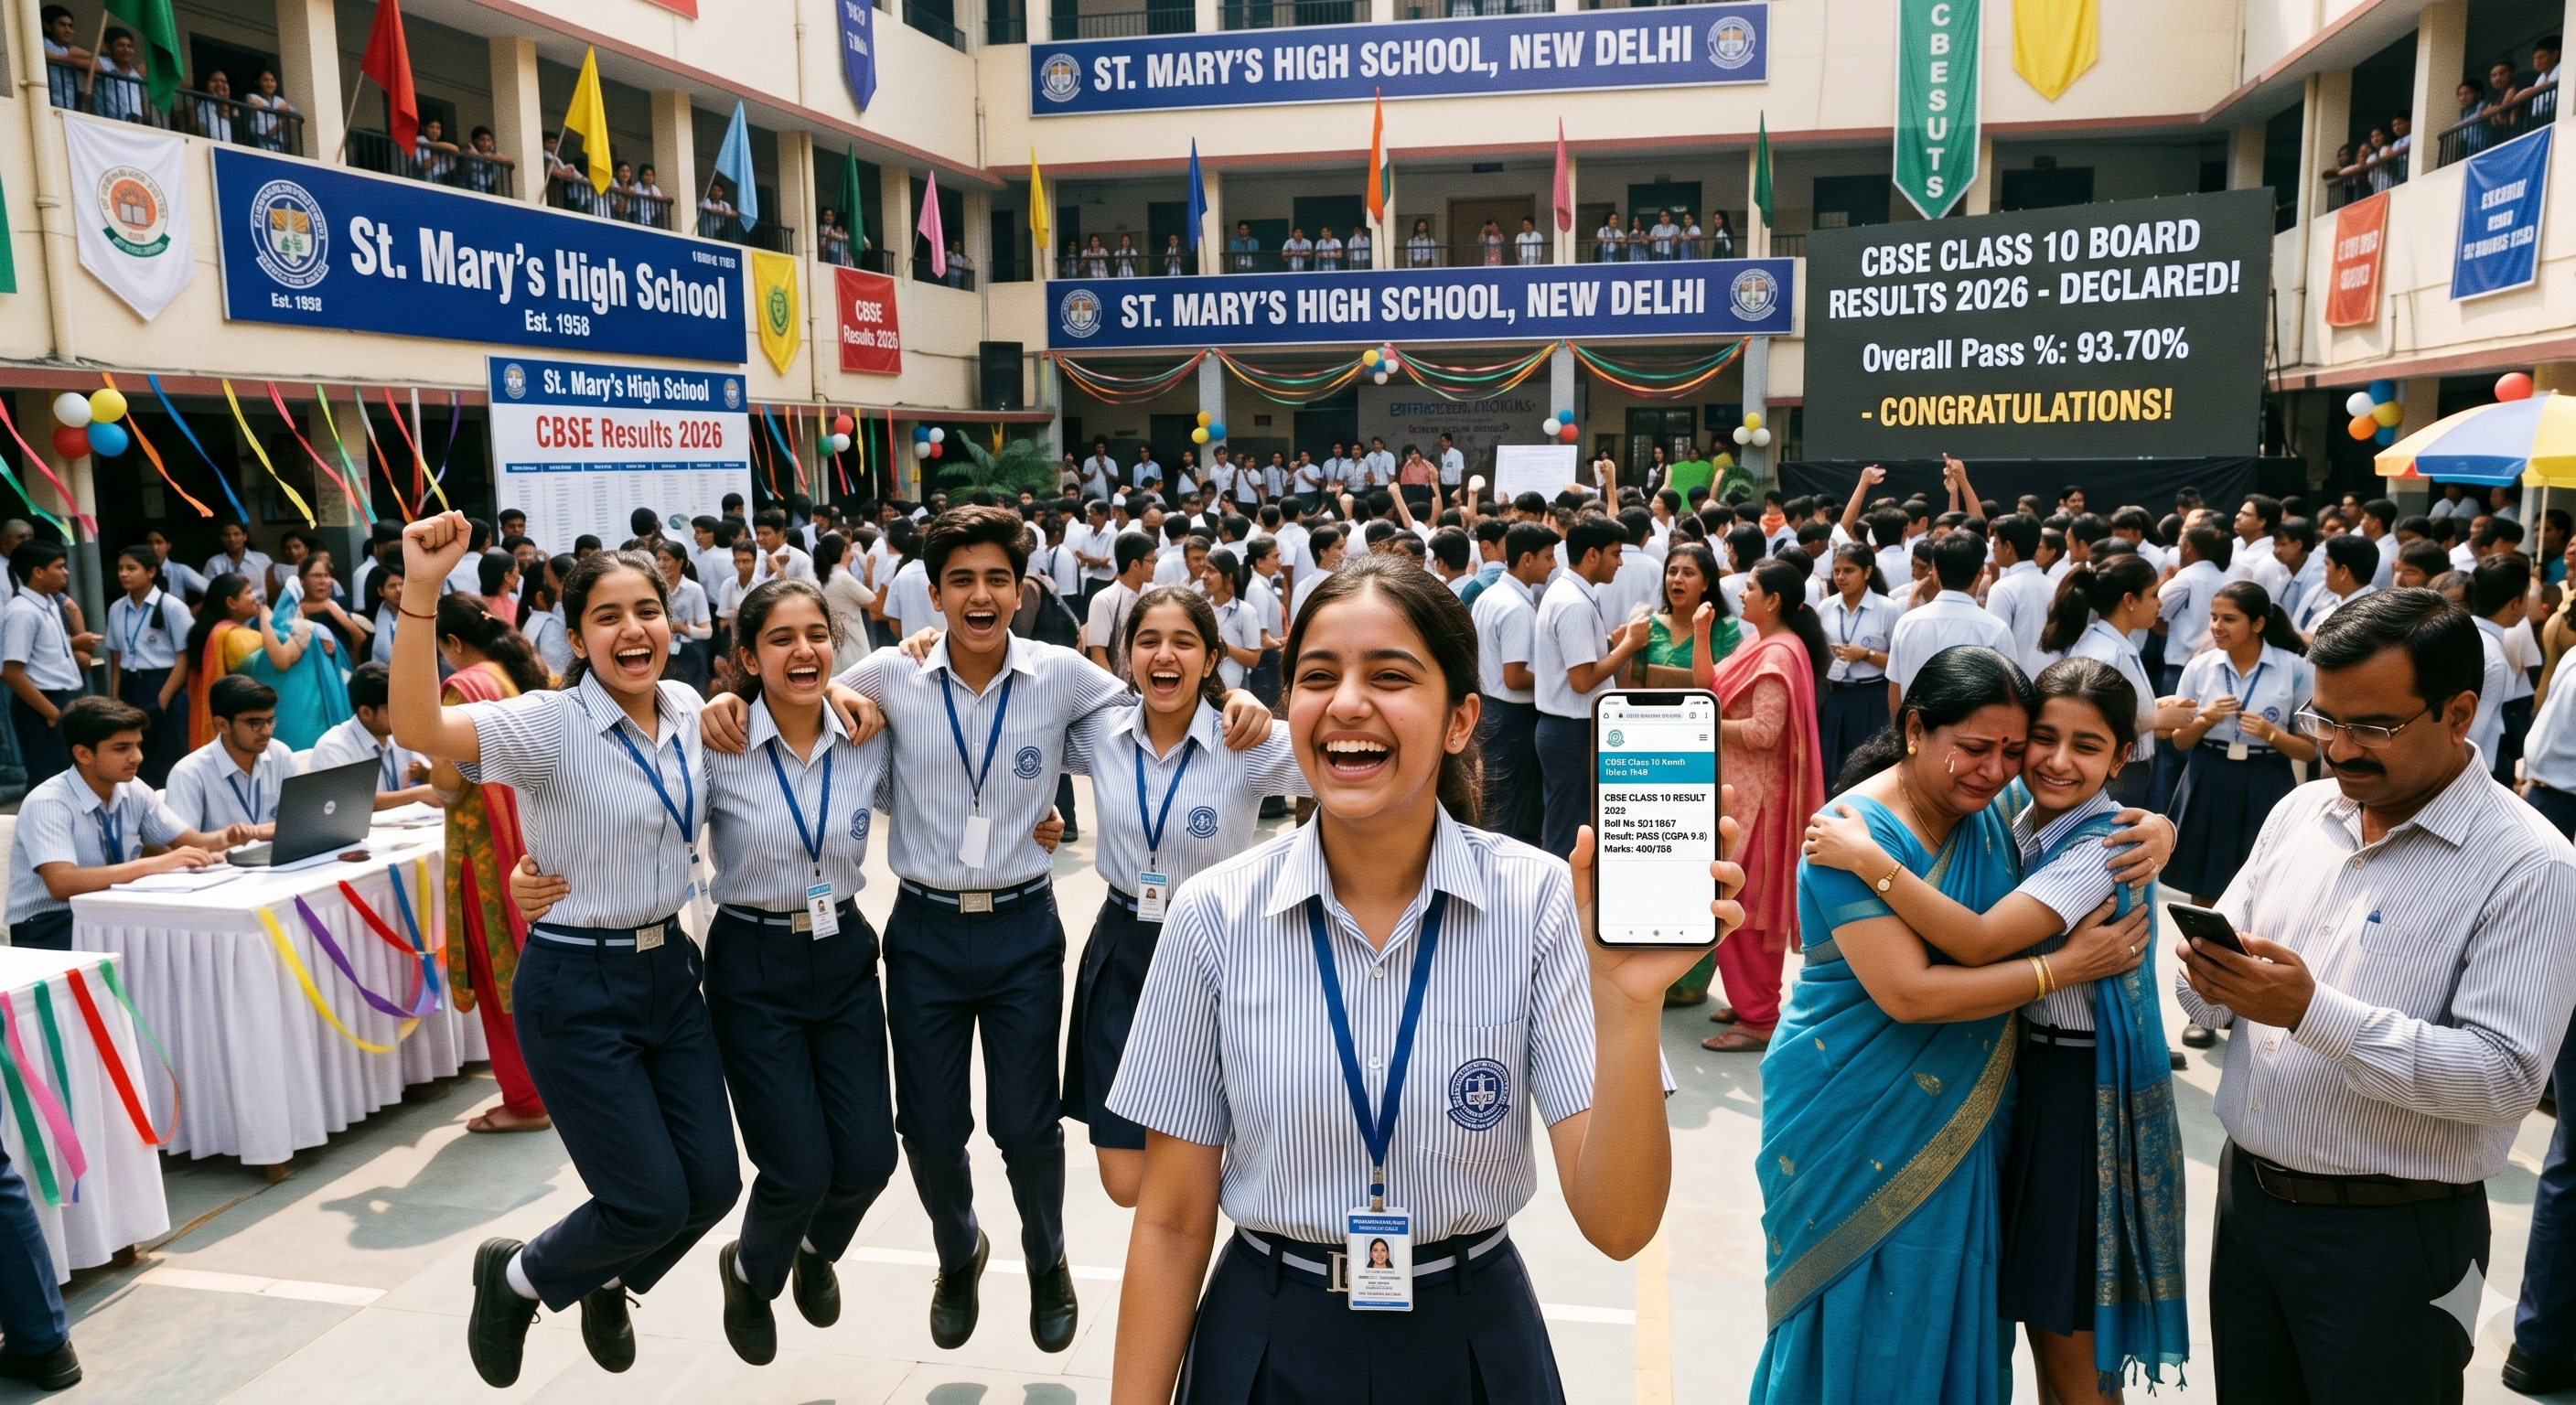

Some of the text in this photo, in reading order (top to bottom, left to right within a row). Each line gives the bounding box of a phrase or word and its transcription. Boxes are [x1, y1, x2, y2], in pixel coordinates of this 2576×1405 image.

[1093, 26, 1692, 91] ST. MARY’S HIGH SCHOOL, NEW DELHI
[1926, 3, 1950, 198] CBESUTS
[1862, 219, 2201, 277] CBSE CLASS 10 BOARD
[349, 216, 407, 279] St.
[419, 227, 546, 305] Mary’s
[555, 249, 628, 315] High
[636, 263, 727, 319] School
[271, 292, 293, 308] Est.
[1121, 278, 1705, 328] ST. MARY’S HIGH SCHOOL, NEW DELHI
[1830, 281, 1948, 319] RESULTS
[1955, 275, 2029, 311] 2026
[2059, 260, 2240, 305] DECLARED!
[524, 309, 590, 337] Est. 1958
[855, 299, 883, 323] CBSE
[843, 324, 899, 349] Results 2026
[1862, 327, 2189, 373] Overall Pass %: 93.70%
[543, 369, 710, 404] St. Mary’s High School
[1880, 387, 2174, 427] CONGRATULATIONS!
[536, 415, 724, 448] CBSE Results 2026
[1605, 844, 1634, 853] Marks:
[1661, 831, 1689, 842] (CGPA
[1690, 831, 1708, 842] 9.8)
